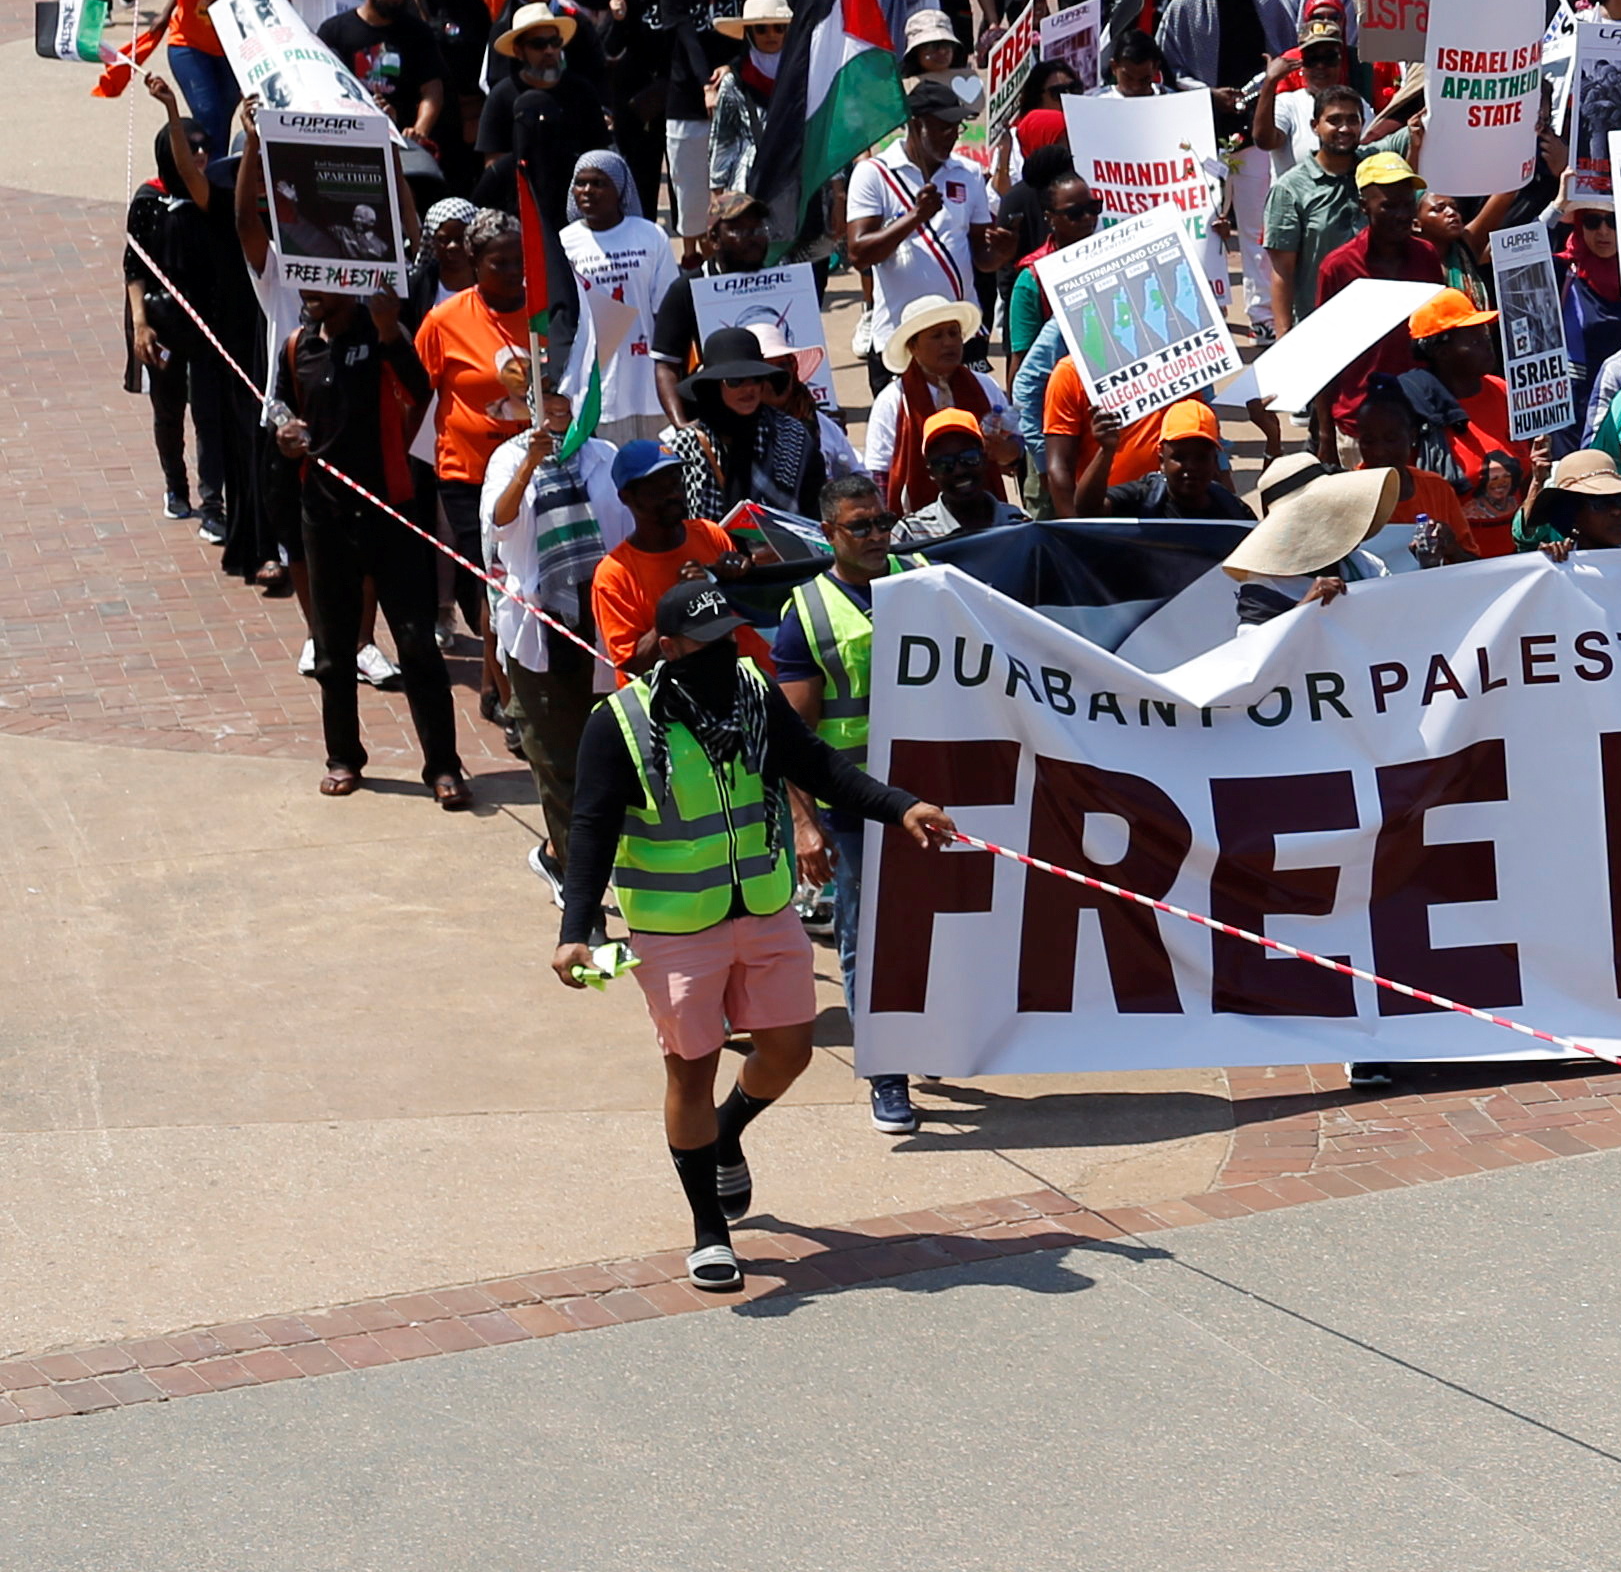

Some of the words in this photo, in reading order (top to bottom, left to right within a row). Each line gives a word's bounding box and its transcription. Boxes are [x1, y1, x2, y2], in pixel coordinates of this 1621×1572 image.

[989, 8, 1034, 95] FREE
[1437, 47, 1508, 73] ISRAEL
[1512, 44, 1528, 69] IS
[1441, 67, 1539, 100] APARTHEID
[280, 115, 366, 131] LAJPAAL
[1467, 101, 1522, 128] STATE
[316, 171, 382, 184] APARTHEID
[1092, 157, 1197, 188] AMANDLA
[604, 248, 648, 259] Against
[1062, 217, 1155, 264] LAJPAAL
[1501, 231, 1540, 250] LAJPAAL
[582, 259, 640, 275] Apartheid
[1120, 247, 1147, 270] LAND
[285, 263, 323, 283] FREE
[326, 267, 399, 289] PALESTINE
[595, 272, 630, 286] Israel
[714, 273, 792, 294] LAJPAAL
[1094, 360, 1149, 395] END
[1156, 328, 1220, 363] THIS
[1509, 354, 1568, 390] ISRAEL
[1099, 381, 1147, 413] ILLEGAL
[1146, 341, 1226, 390] OCCUPATION
[1137, 357, 1233, 413] PALESTINE
[1512, 385, 1554, 413] KILLERS
[1553, 379, 1570, 400] OF
[1513, 401, 1573, 436] HUMANITY
[869, 736, 1521, 1020] FREE
